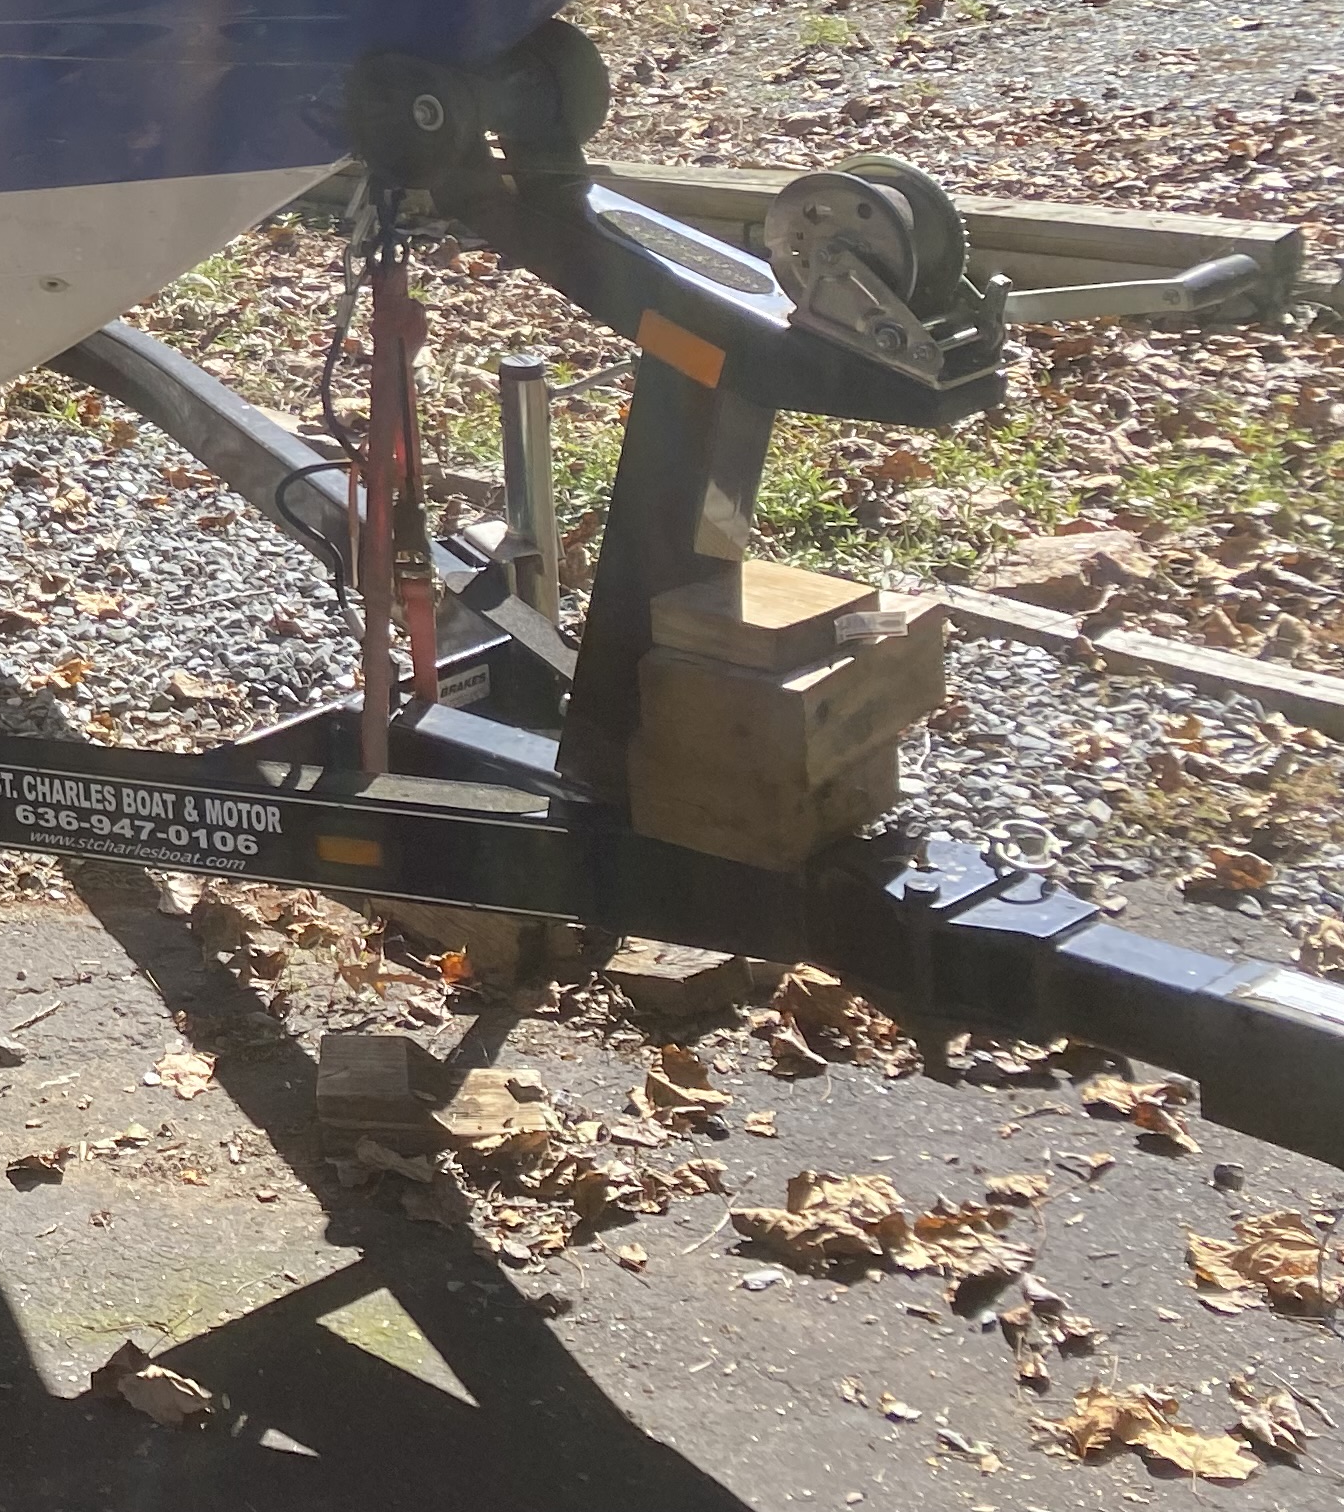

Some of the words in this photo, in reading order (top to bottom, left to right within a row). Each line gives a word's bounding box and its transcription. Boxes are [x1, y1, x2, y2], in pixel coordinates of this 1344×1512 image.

[440, 671, 486, 699] BRAKES
[22, 774, 117, 813] CHARLES
[122, 787, 177, 820] BOAT
[183, 795, 200, 824] &
[204, 798, 283, 834] MOTOR
[14, 803, 259, 856] 636-947-0106
[28, 828, 247, 871] www.stcharlesboat.com
